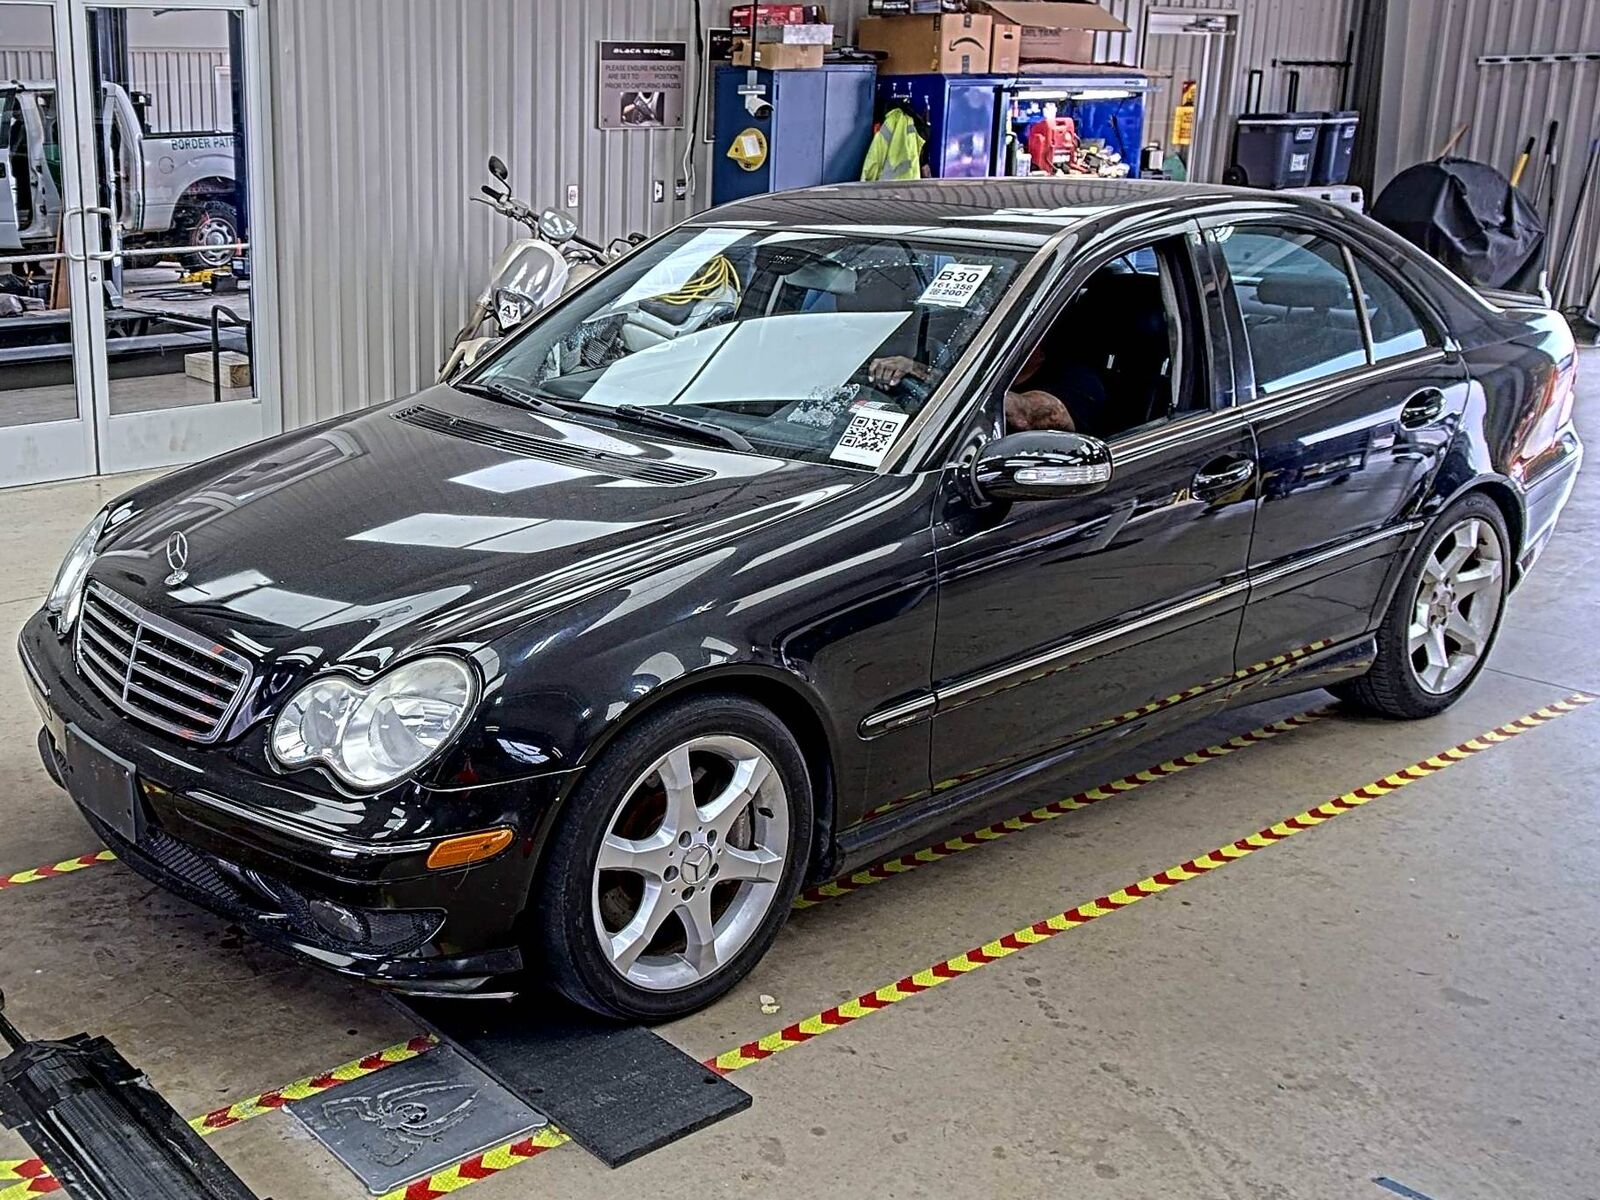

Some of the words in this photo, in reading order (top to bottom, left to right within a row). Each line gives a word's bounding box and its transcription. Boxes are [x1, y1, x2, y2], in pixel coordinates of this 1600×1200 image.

[171, 138, 211, 151] BORDER
[938, 271, 980, 283] B30
[941, 289, 969, 297] 2007
[502, 305, 519, 318] A1
